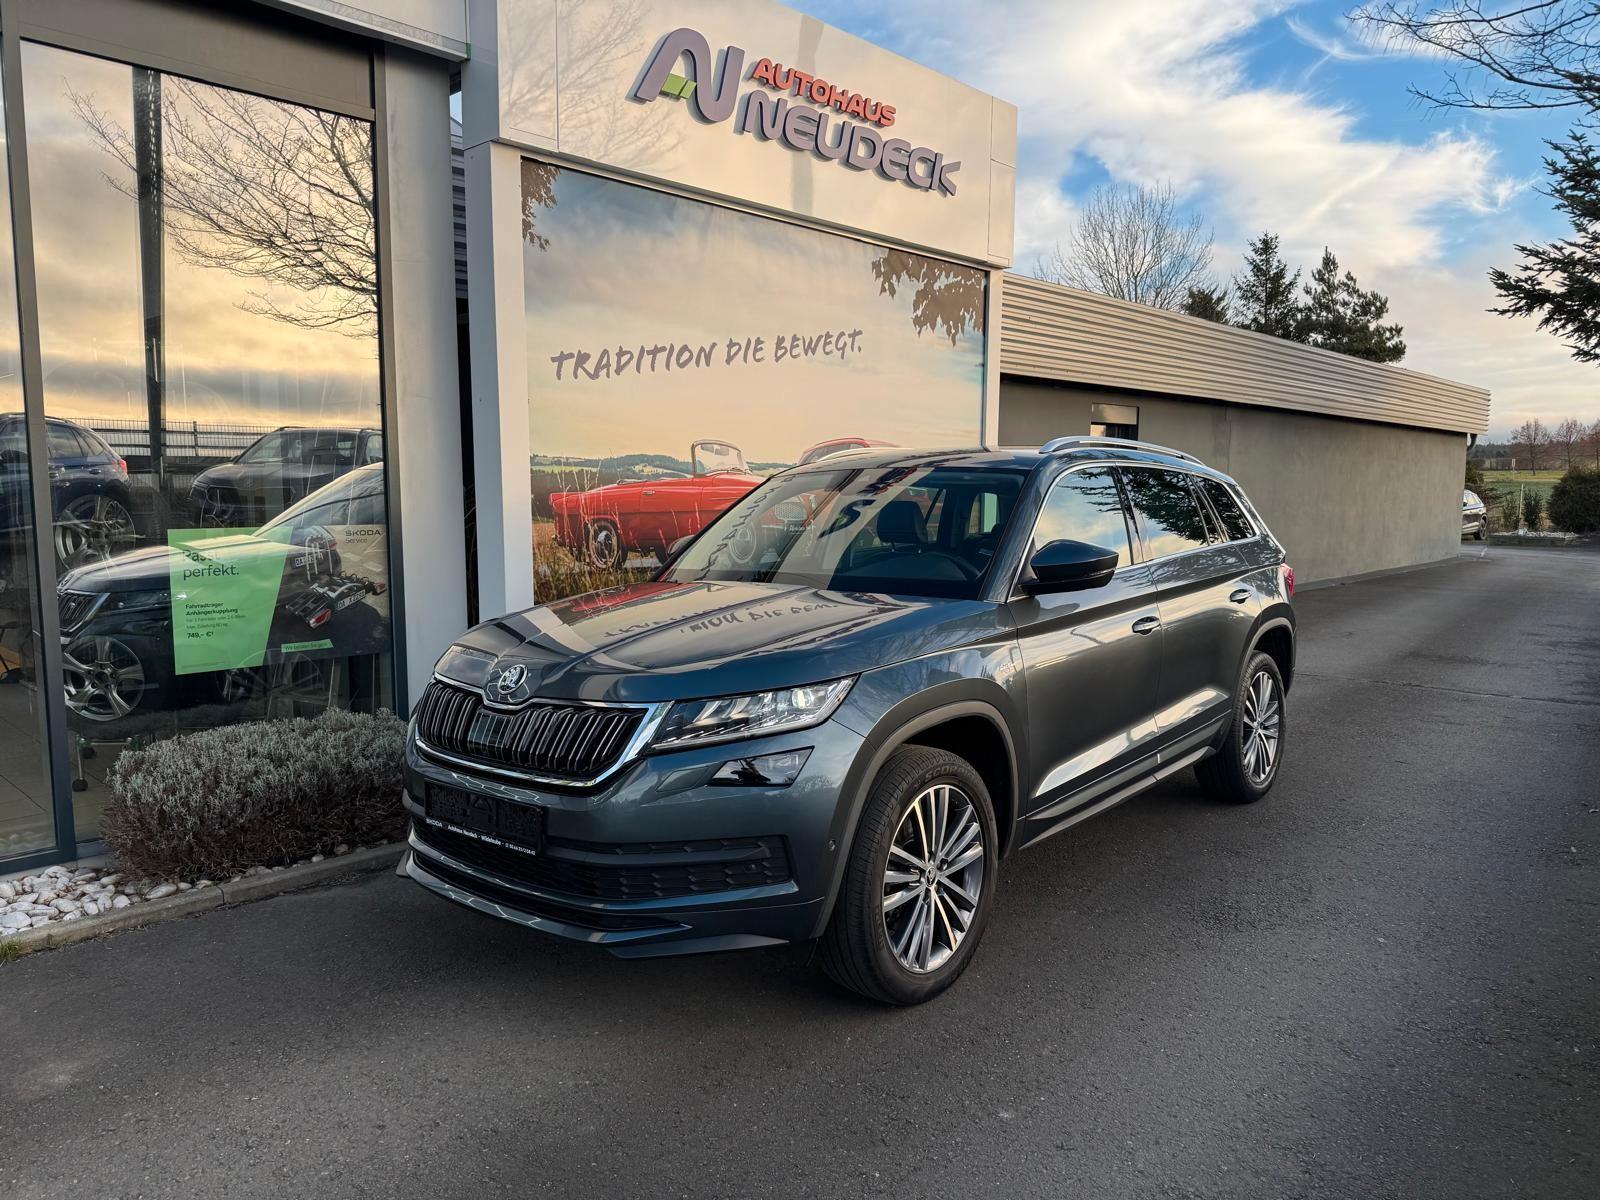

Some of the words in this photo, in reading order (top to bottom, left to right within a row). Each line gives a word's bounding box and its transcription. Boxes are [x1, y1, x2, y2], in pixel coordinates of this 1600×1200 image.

[752, 57, 897, 128] AUTOHAUS
[743, 89, 962, 197] NEUDECK
[550, 342, 718, 381] TRADITION
[725, 337, 765, 366] DIE
[774, 328, 864, 360] BEWEGT.
[183, 563, 240, 581] perfekt.
